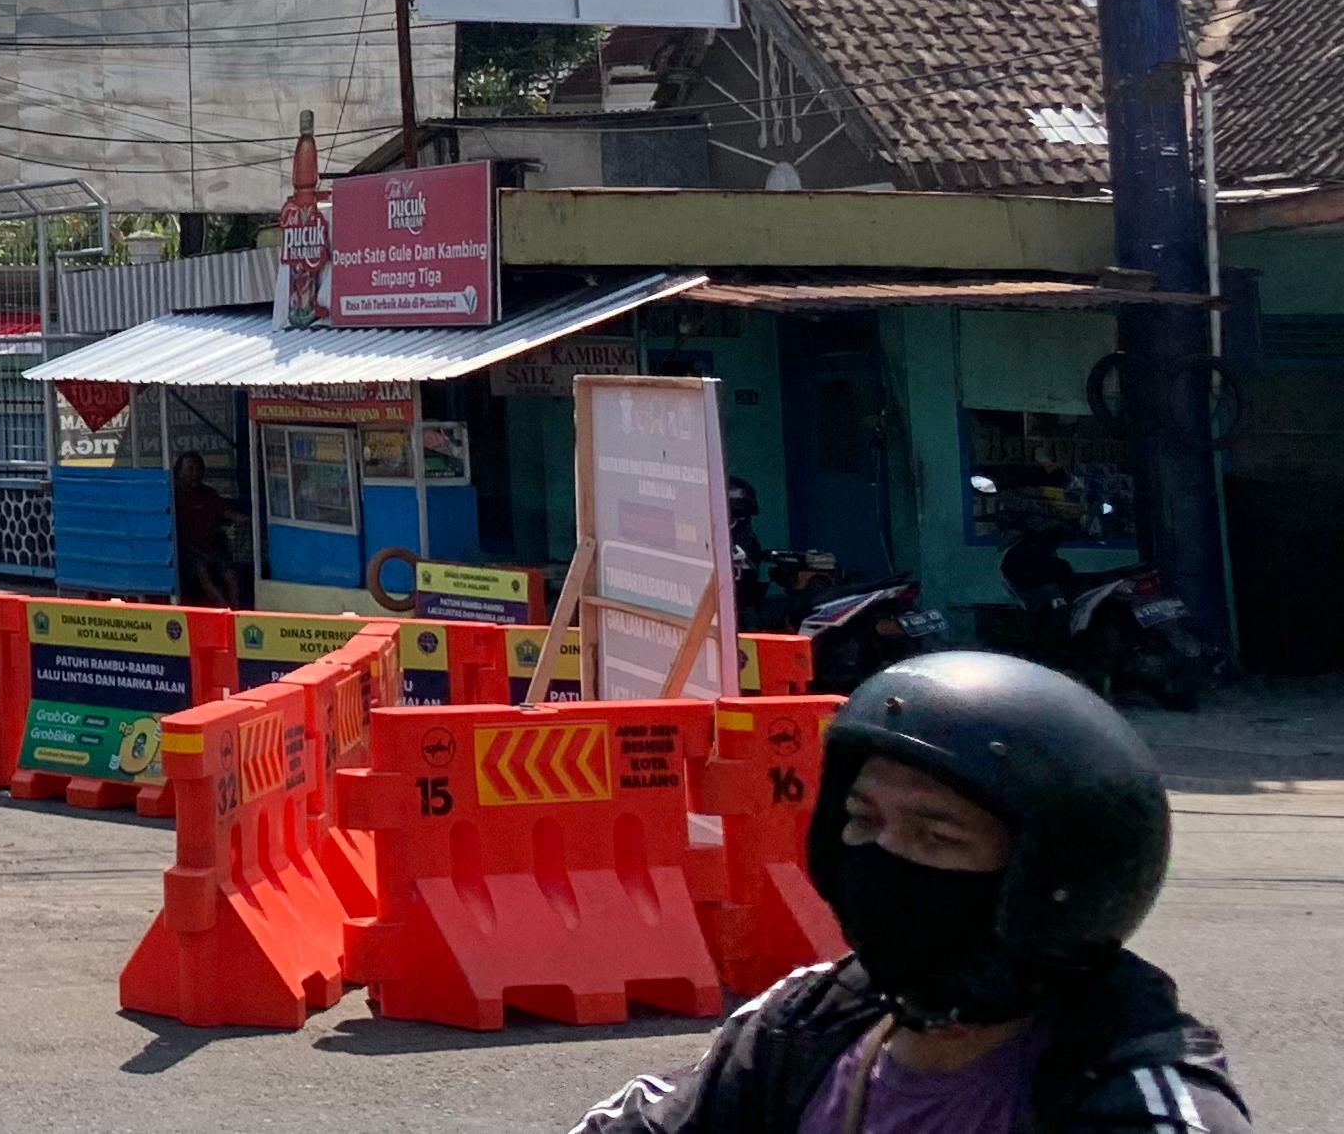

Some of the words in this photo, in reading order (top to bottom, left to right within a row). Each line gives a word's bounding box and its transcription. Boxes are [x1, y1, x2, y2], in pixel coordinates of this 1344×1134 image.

[387, 191, 427, 230] pucuk
[283, 219, 325, 260] pucuk
[333, 249, 362, 267] Depot
[364, 247, 386, 263] Sate
[388, 244, 412, 262] Gule
[415, 244, 435, 261] Dan
[438, 239, 487, 260] Kambing
[371, 270, 416, 288] Simpang
[418, 267, 442, 287] Tiga
[62, 614, 86, 626] DINAS
[87, 616, 152, 631] PERHUBUNGAN
[77, 628, 100, 639] KOTA
[101, 630, 138, 642] MALANG
[280, 627, 313, 639] DINAS
[299, 642, 331, 654] KOTA
[559, 644, 580, 655] DIN
[55, 654, 89, 667] PATUHI
[90, 658, 164, 676] RAMBU-RAMBU
[37, 668, 60, 681] LALU
[62, 670, 94, 684] LINTAS
[95, 674, 116, 687] DAN
[117, 676, 152, 691] MARKA
[154, 680, 186, 694] JALAN
[36, 708, 81, 724] GrabCar
[30, 727, 76, 744] GrabBike
[630, 756, 668, 772] KOTA
[619, 773, 679, 789] MALANG
[768, 765, 804, 804] 16
[415, 776, 453, 817] 15
